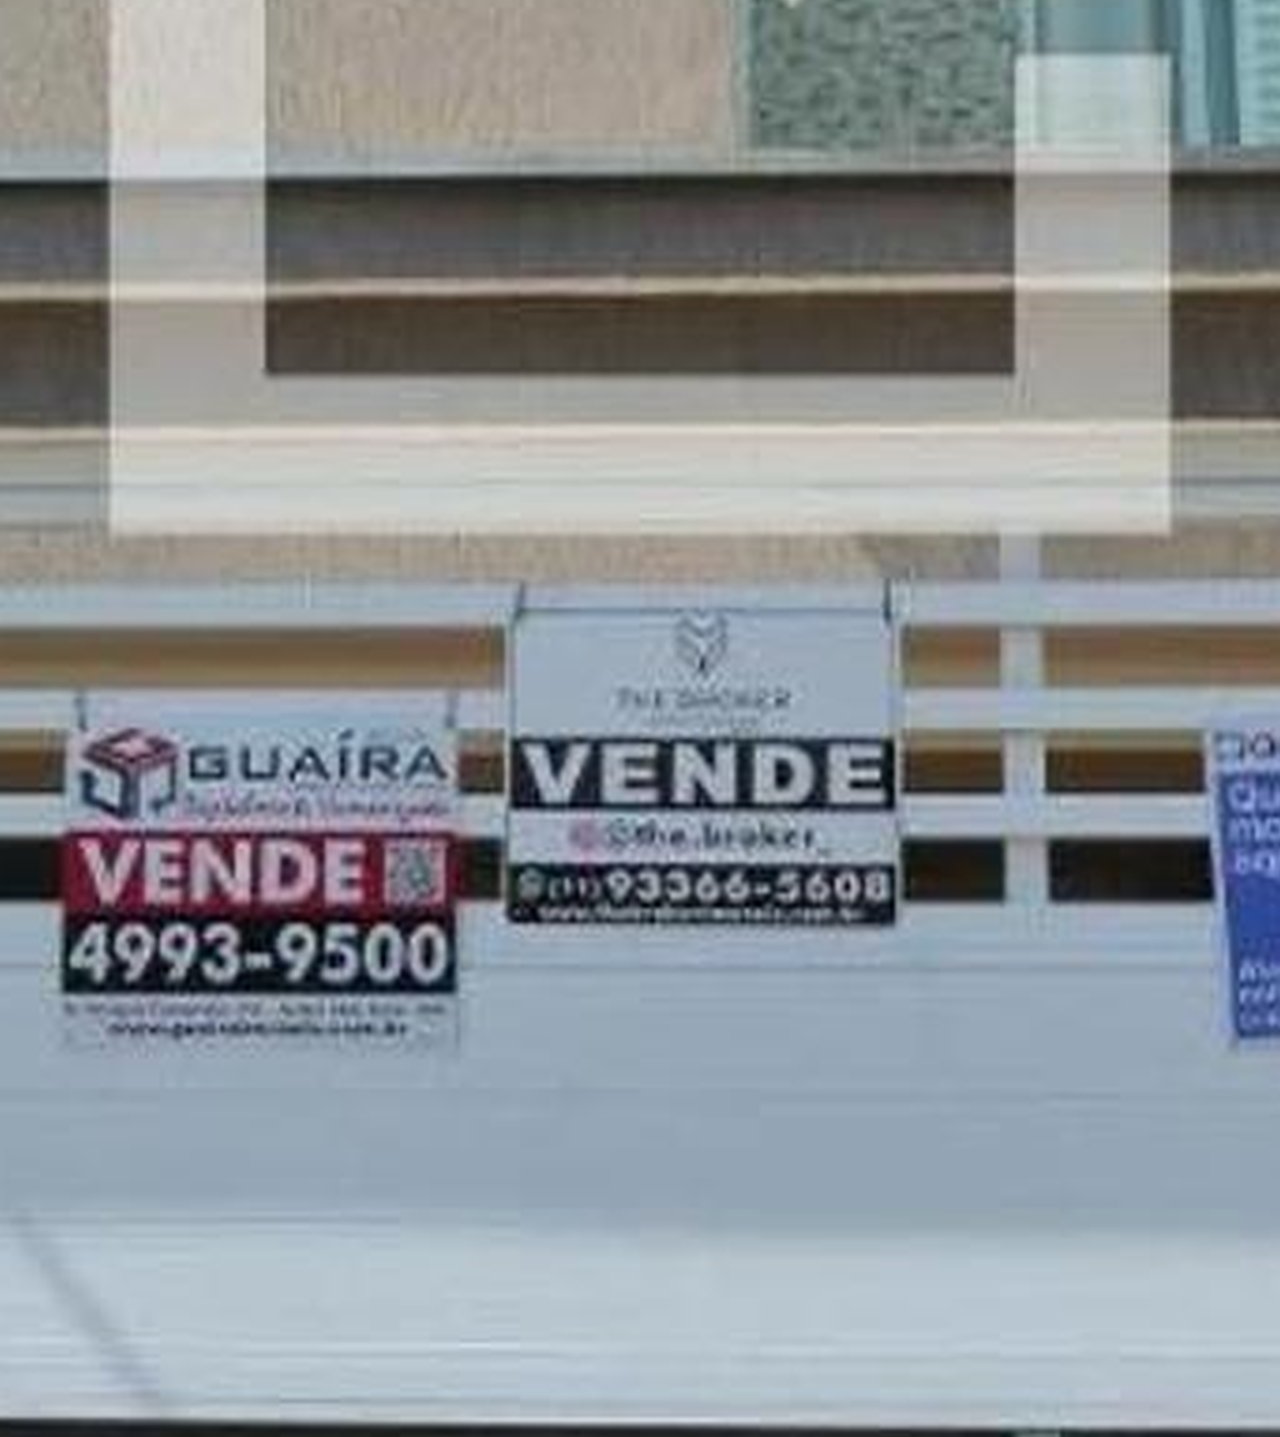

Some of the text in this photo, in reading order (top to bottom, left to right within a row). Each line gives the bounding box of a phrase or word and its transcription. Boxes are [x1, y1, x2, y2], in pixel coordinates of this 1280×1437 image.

[188, 729, 448, 782] GUAÍRA
[521, 742, 886, 805] VENDE
[78, 836, 366, 905] VENDE
[69, 922, 449, 983] 4993-9500
